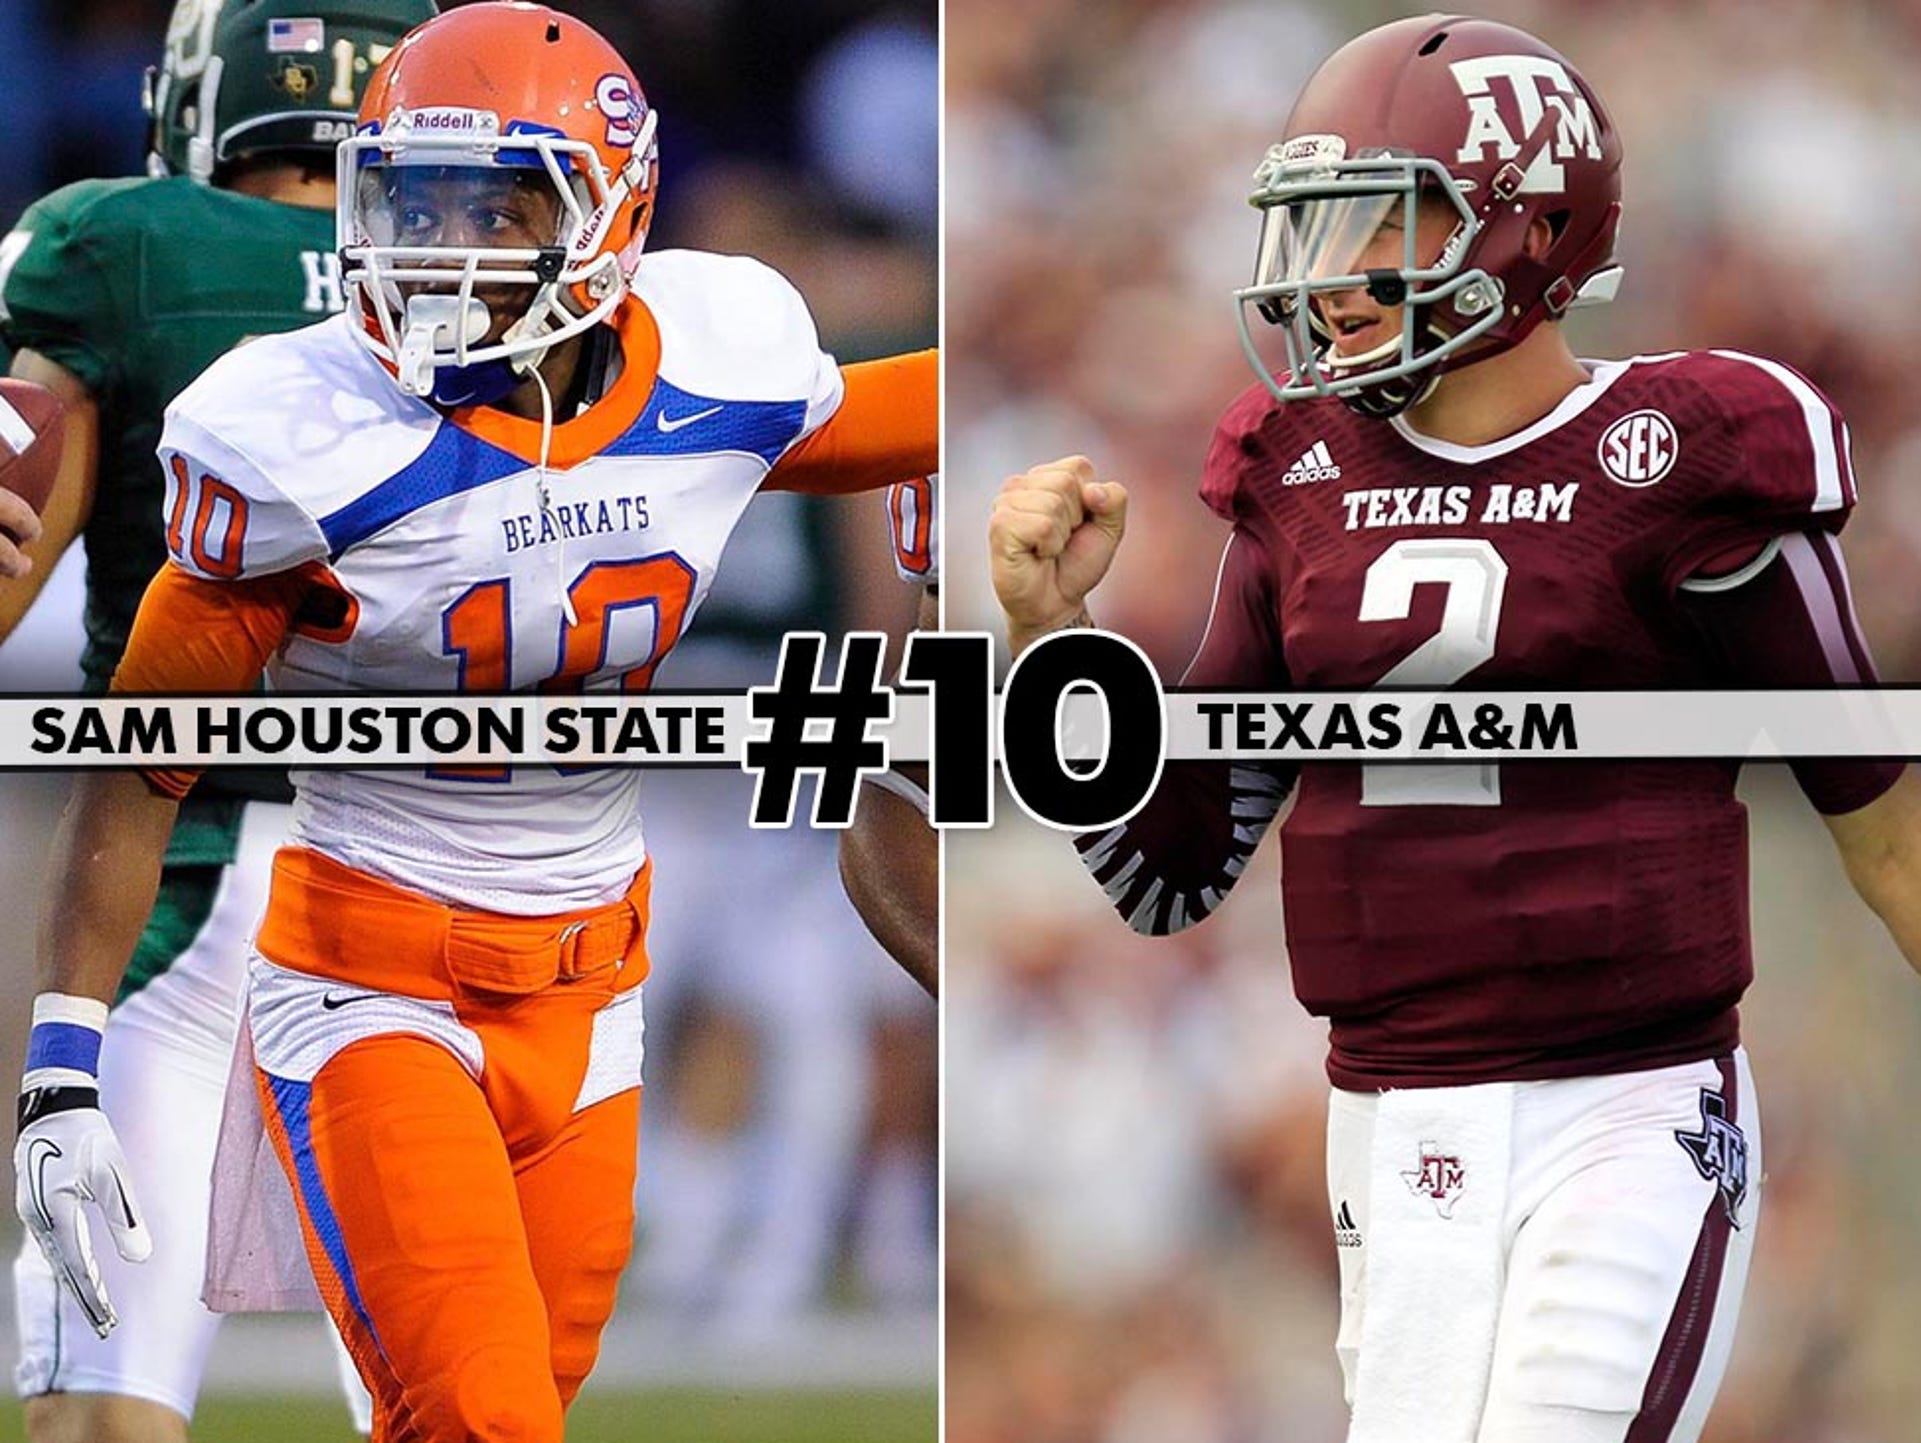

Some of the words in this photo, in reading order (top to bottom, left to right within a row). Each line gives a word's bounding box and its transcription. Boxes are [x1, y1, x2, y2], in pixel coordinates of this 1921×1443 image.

[414, 112, 473, 129] Riddell
[1282, 465, 1341, 486] adidas
[1606, 416, 1670, 480] SEC
[166, 452, 249, 578] 10
[502, 496, 649, 552] BEARKATS
[1342, 485, 1471, 530] TEXAS
[1480, 482, 1580, 523] A&M
[441, 550, 698, 783] 10
[1357, 538, 1509, 806] 2
